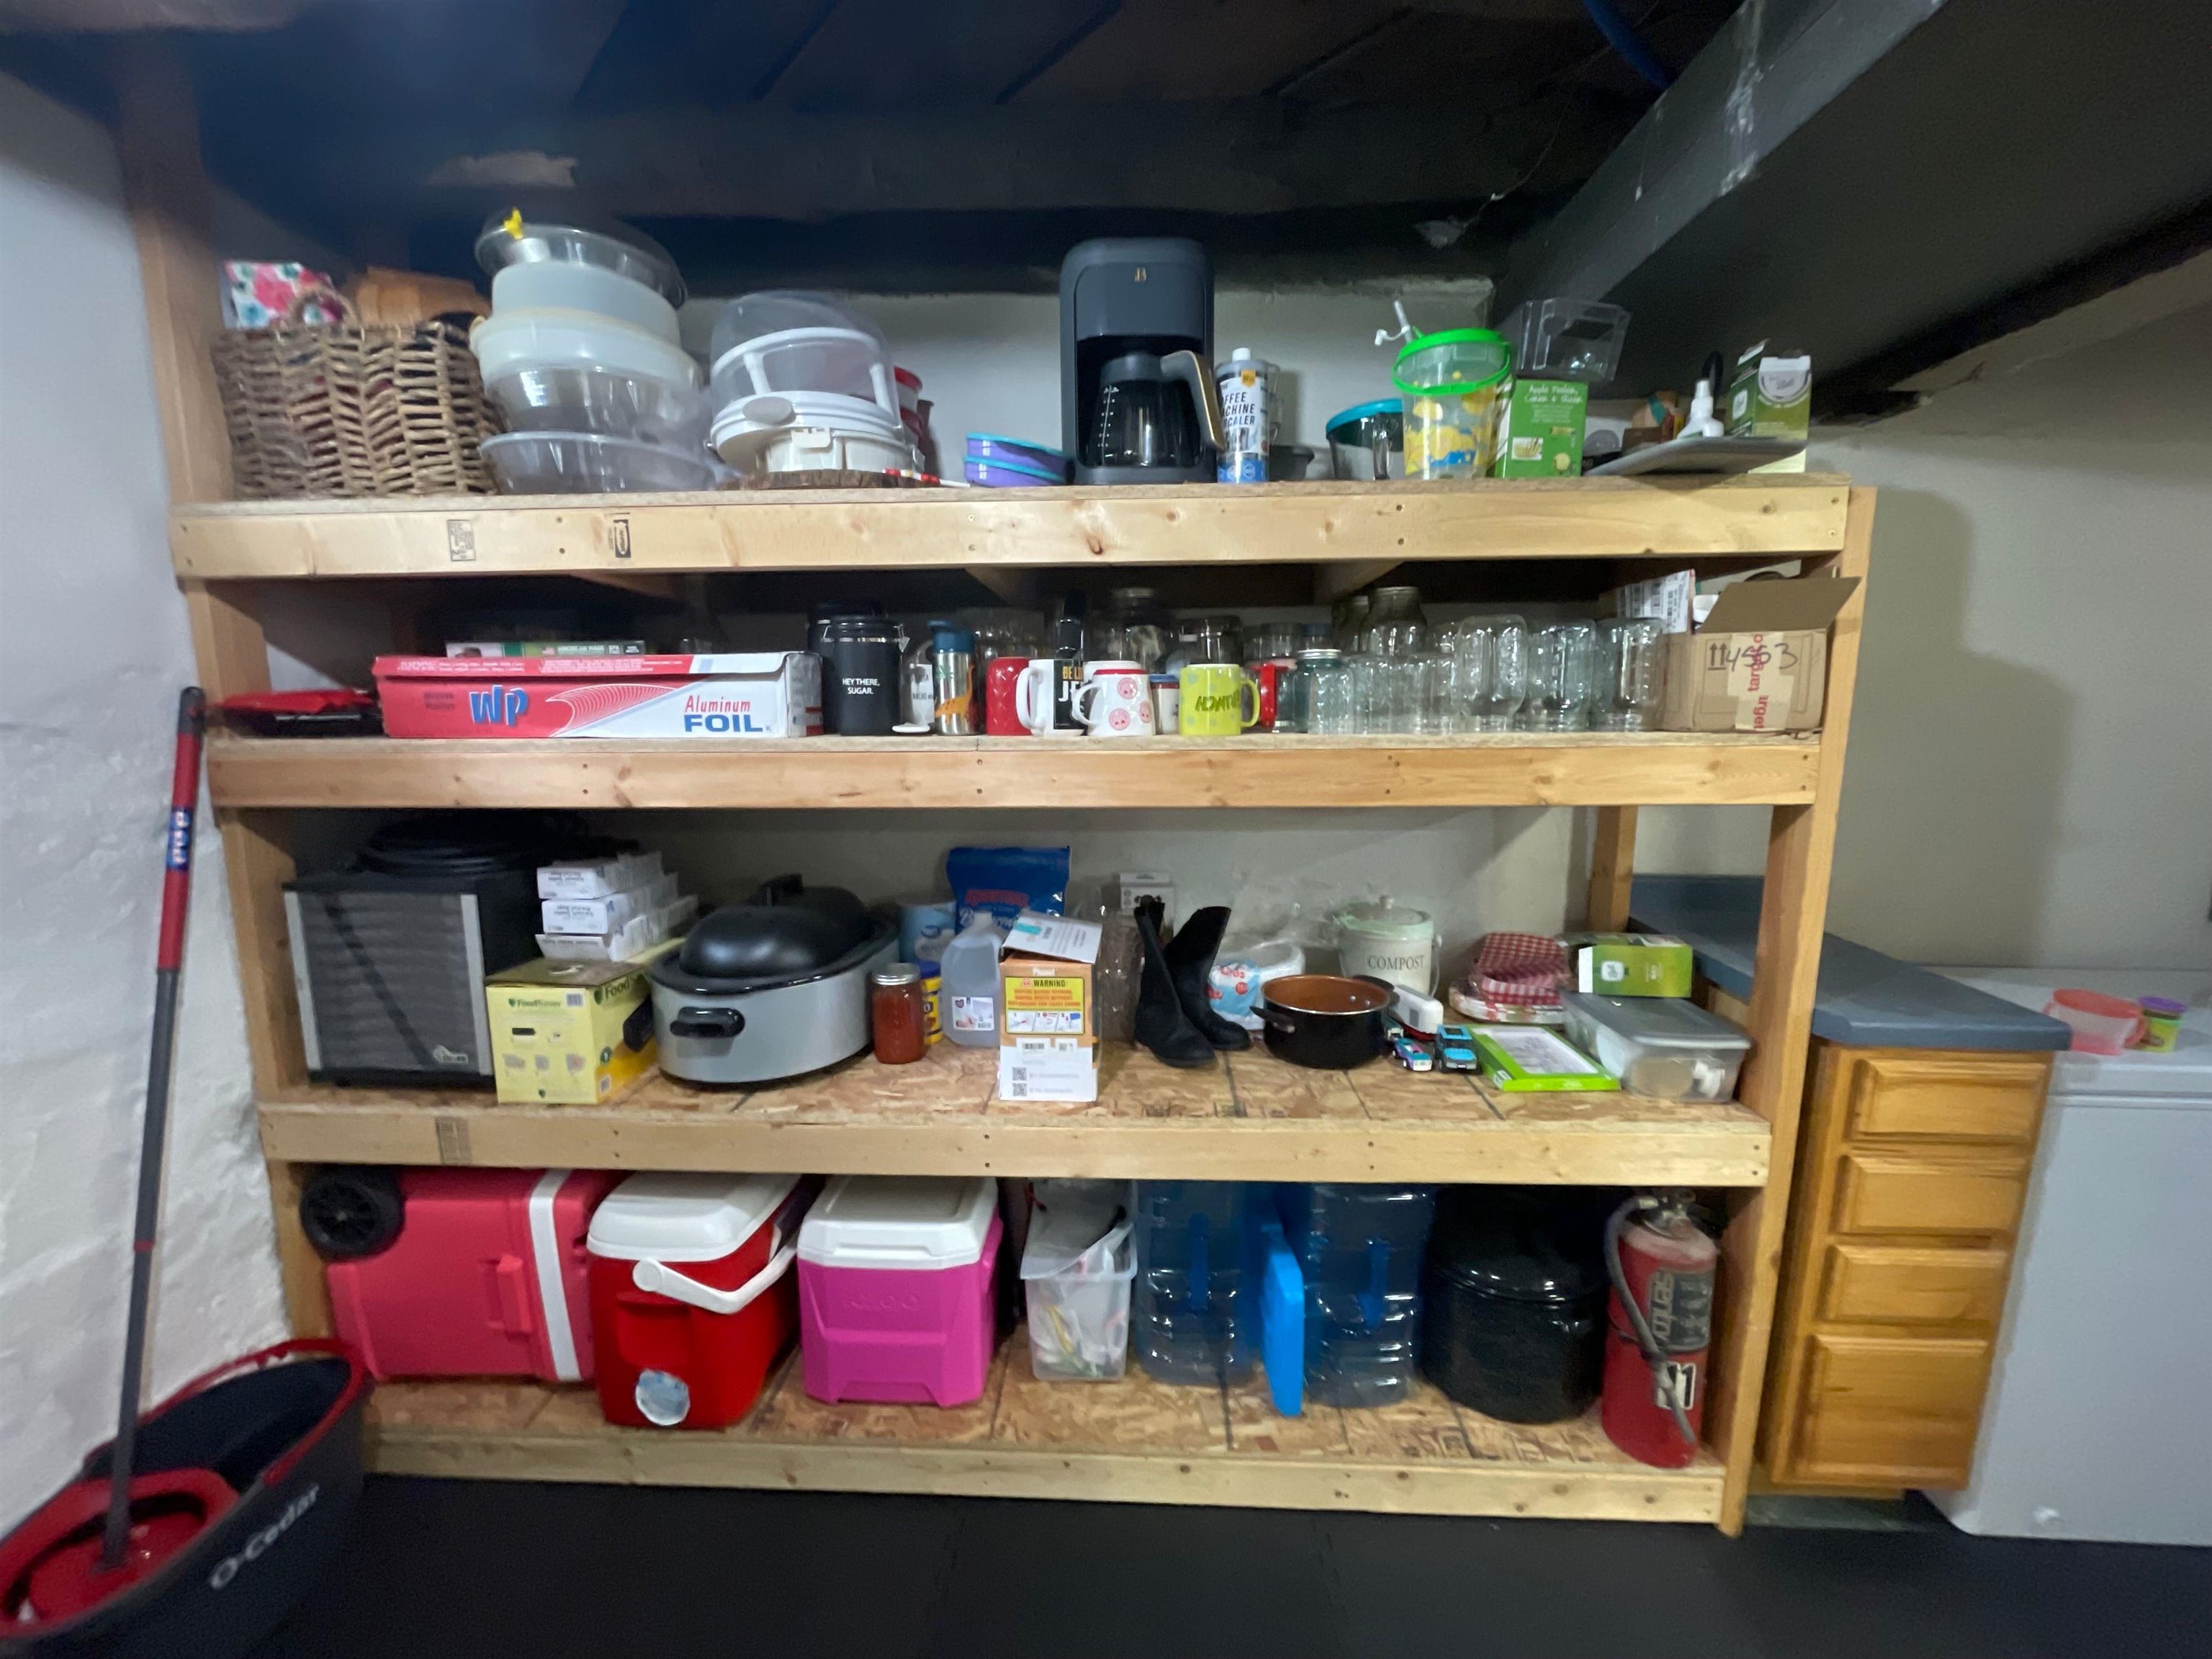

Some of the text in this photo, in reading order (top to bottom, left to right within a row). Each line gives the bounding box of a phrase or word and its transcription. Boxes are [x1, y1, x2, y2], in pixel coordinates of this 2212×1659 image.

[469, 685, 529, 726] WP
[685, 695, 750, 713] Aluminum
[684, 714, 763, 732] FOIL
[1368, 955, 1425, 970] COMPOST
